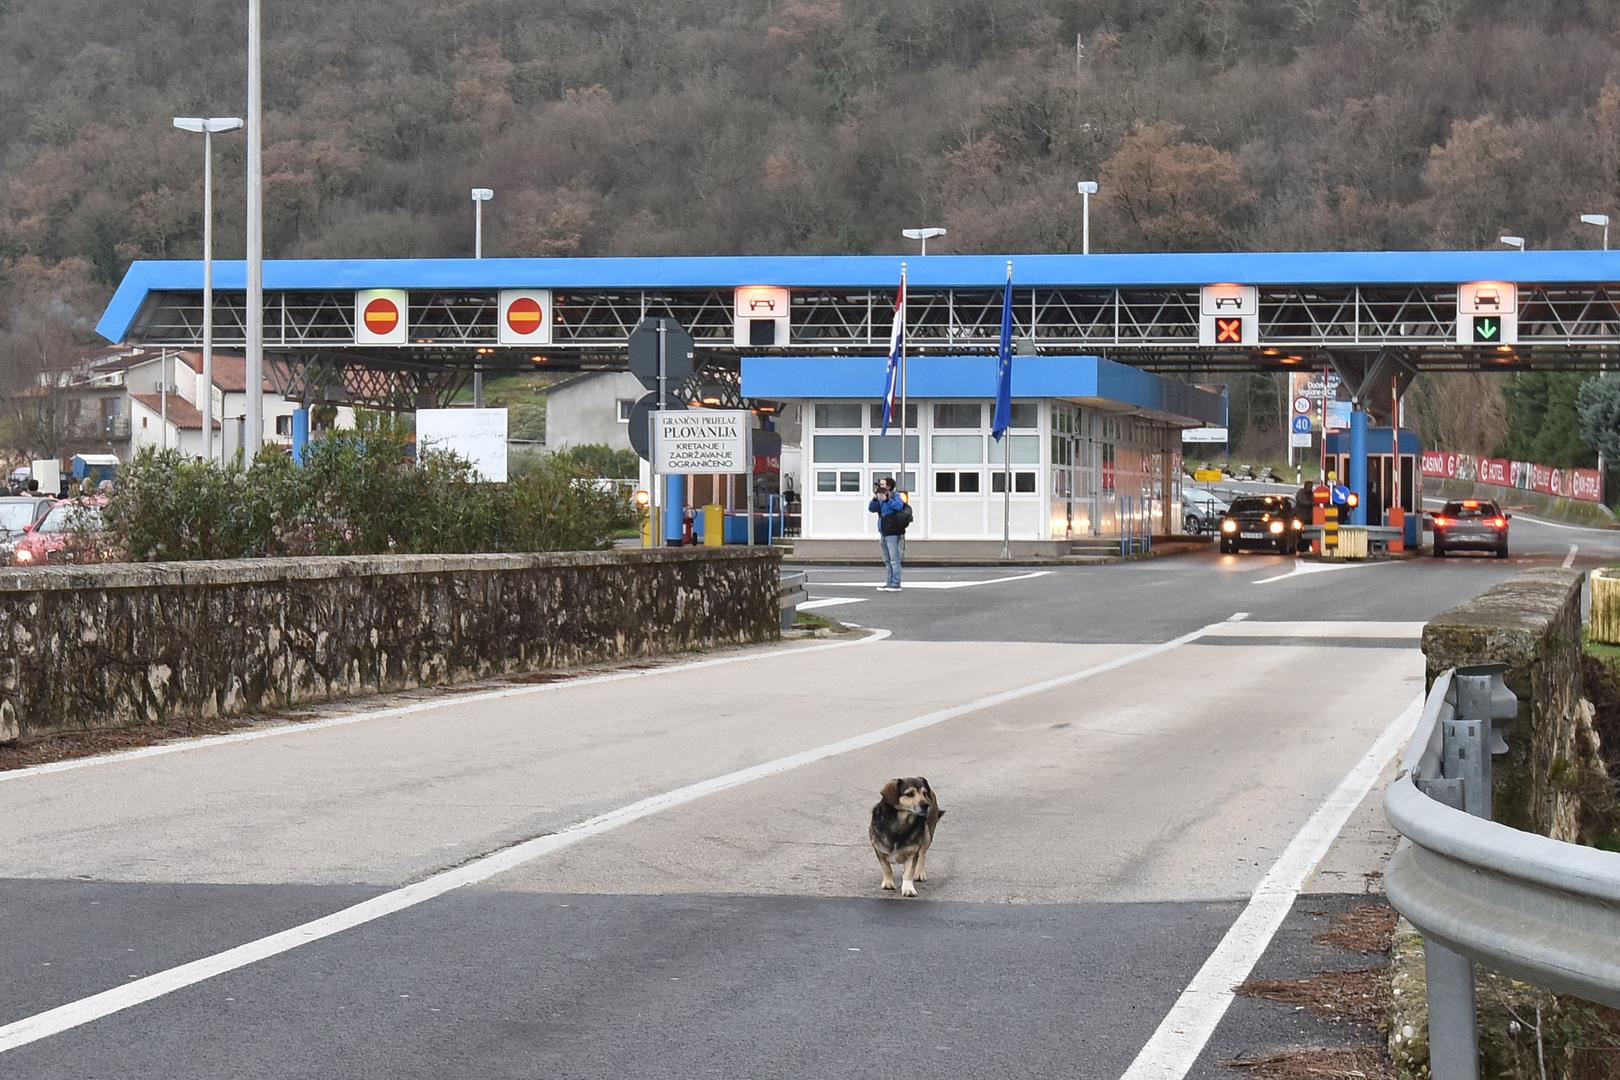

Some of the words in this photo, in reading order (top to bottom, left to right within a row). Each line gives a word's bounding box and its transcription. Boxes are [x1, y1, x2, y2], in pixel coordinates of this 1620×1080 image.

[662, 416, 699, 425] GRANIČNI
[702, 416, 736, 425] PRIJELAZ
[1295, 418, 1308, 430] 40
[664, 426, 738, 438] PLOVANIJA
[676, 442, 720, 450] KRETANJE
[669, 451, 733, 459] ZADRŽAVANJE
[668, 459, 734, 468] OGRANIČENO
[1489, 463, 1505, 481] HOTEL
